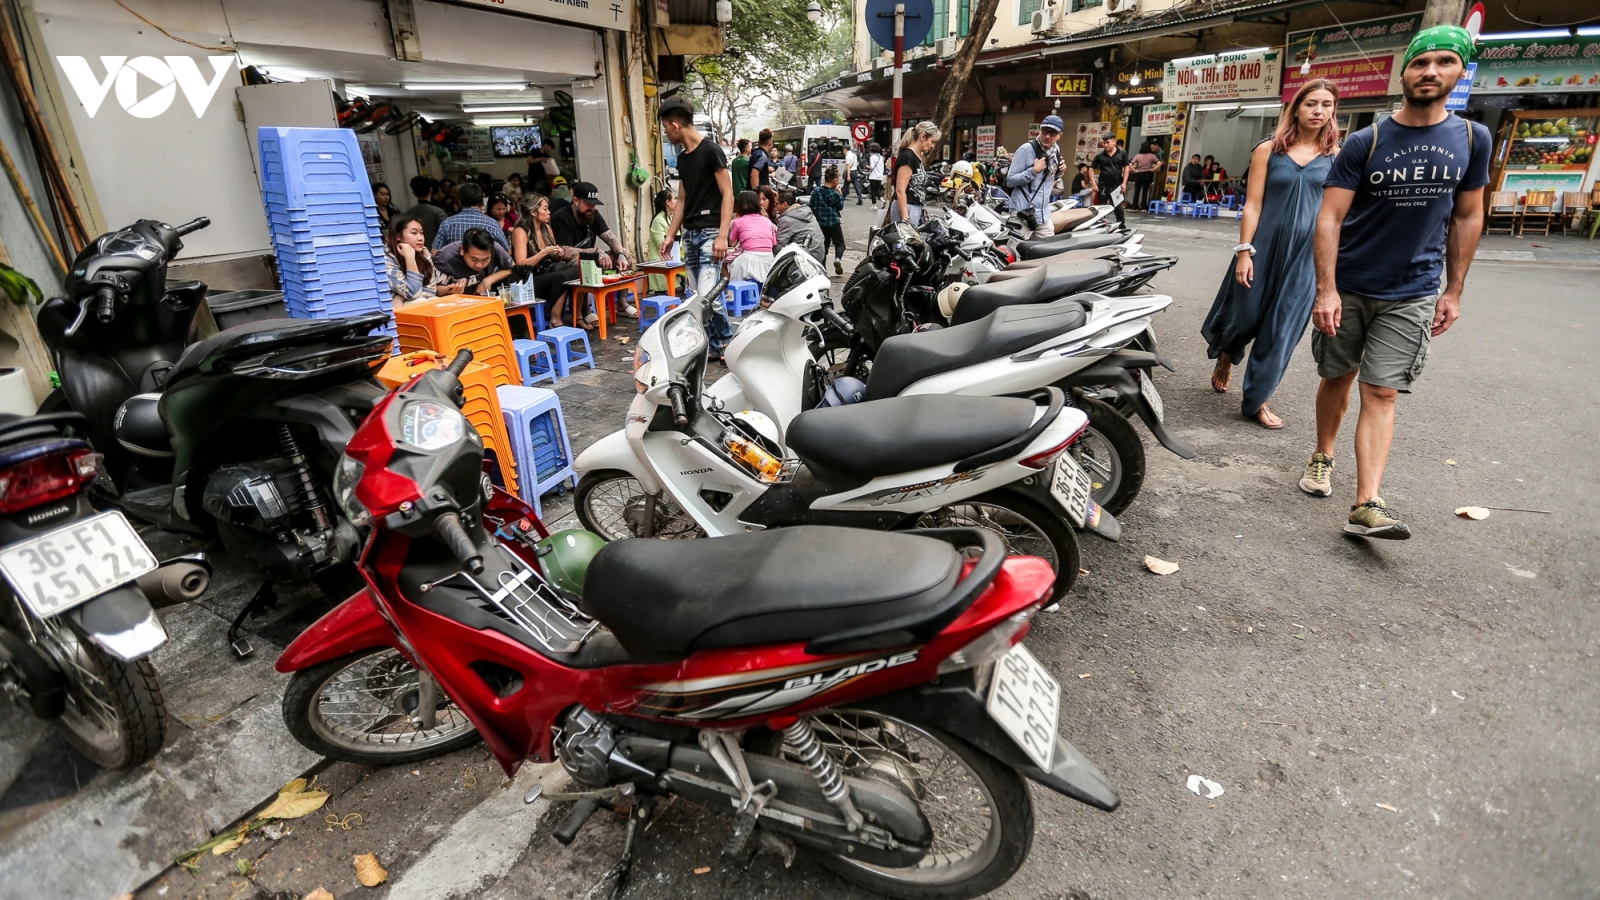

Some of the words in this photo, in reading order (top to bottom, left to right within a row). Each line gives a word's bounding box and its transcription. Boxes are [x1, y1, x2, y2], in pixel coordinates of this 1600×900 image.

[1544, 44, 1579, 57] HOA
[1192, 57, 1212, 66] LONG
[1223, 62, 1237, 81] BÒ
[1240, 59, 1261, 80] KHÔ
[1144, 68, 1164, 79] Minh
[1056, 77, 1087, 92] CAFÉ
[1385, 145, 1455, 162] CALIFORNIA
[1370, 166, 1461, 184] O'NEILL
[680, 467, 714, 476] HONDA
[1056, 457, 1074, 500] 36-E1
[1070, 469, 1089, 520] 139.80
[28, 505, 70, 524] HONDA
[18, 522, 117, 575] 36-F1
[34, 545, 147, 607] 451.24
[783, 650, 919, 690] BLADE
[1023, 668, 1056, 762] 267.34
